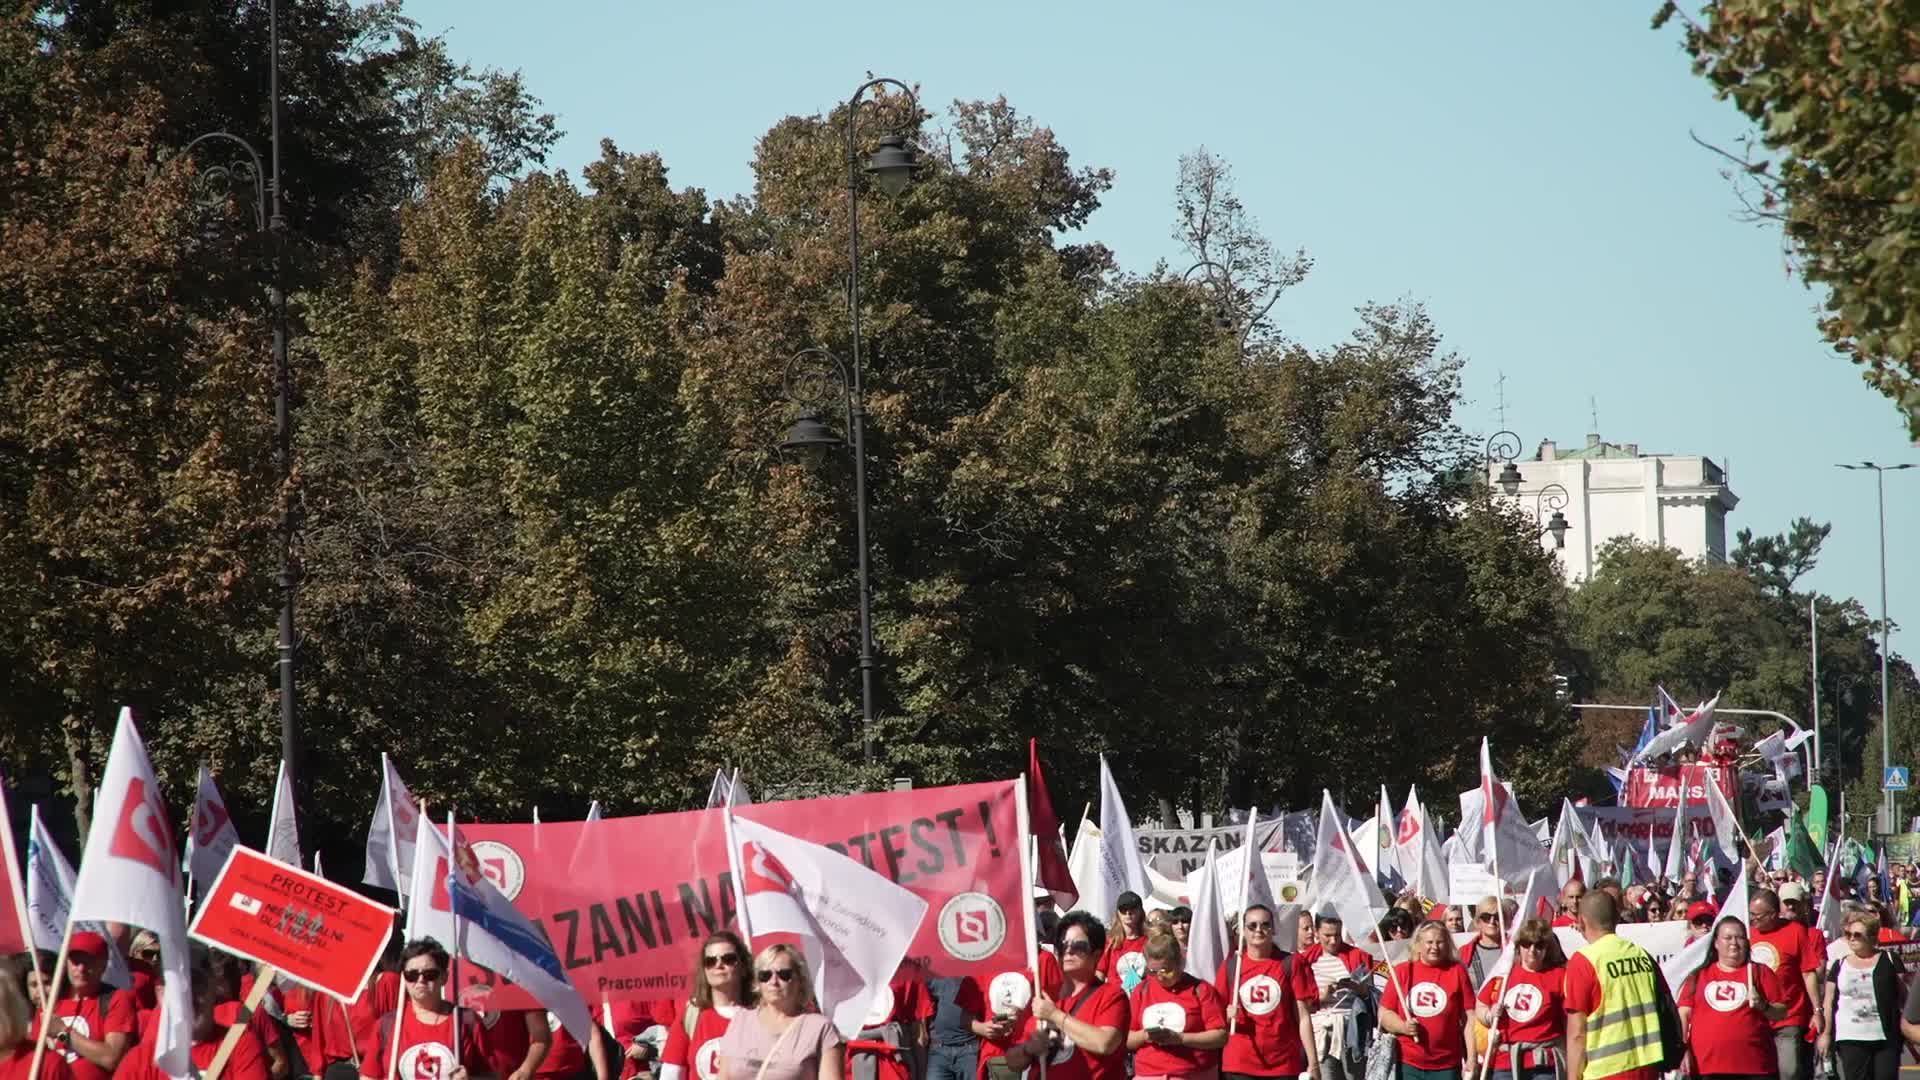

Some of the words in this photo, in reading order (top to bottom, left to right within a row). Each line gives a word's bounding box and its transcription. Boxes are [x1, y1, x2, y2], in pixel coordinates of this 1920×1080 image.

[978, 801, 1001, 857] !
[271, 873, 349, 913] PROTEST
[598, 972, 688, 992] Pracownicy
[1606, 956, 1653, 979] OZZKS
